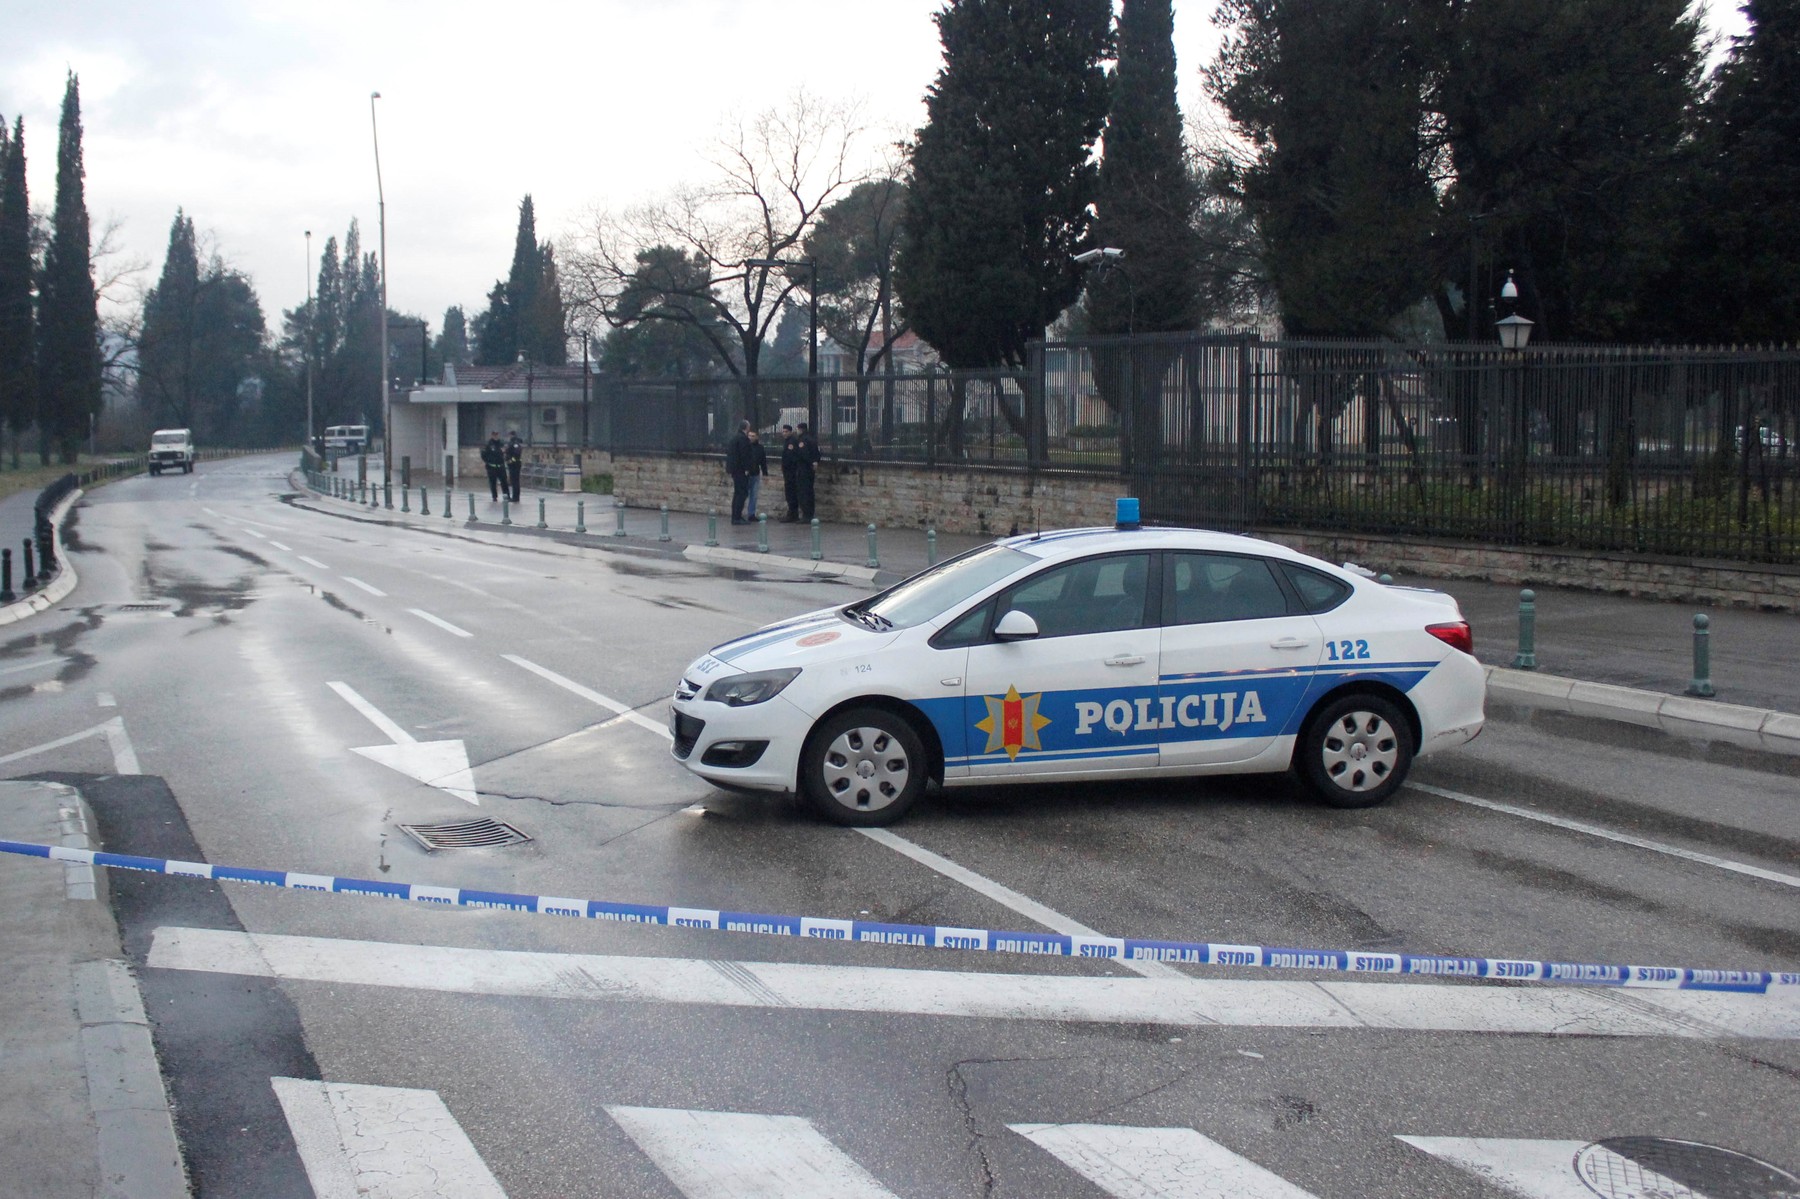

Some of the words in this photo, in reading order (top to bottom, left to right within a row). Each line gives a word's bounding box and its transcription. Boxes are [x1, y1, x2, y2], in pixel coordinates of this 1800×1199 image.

[1325, 639, 1370, 661] 122
[855, 663, 872, 673] 124
[1074, 690, 1267, 736] POLICIJA
[808, 927, 845, 939] STOP
[860, 931, 926, 946] POLICIJA
[943, 936, 981, 950] STOP
[996, 940, 1062, 955] POLICIJA
[1080, 944, 1118, 959] STOP
[1133, 947, 1199, 963] POLICIJA
[1217, 951, 1255, 965] STOP
[1270, 953, 1338, 969] POLICIJA
[1356, 956, 1394, 971] STOP
[1410, 959, 1478, 976] POLICIJA
[1495, 961, 1534, 976] STOP
[1551, 964, 1619, 981] POLICIJA
[1638, 967, 1677, 982] STOP
[1692, 970, 1761, 985] POLICIJA
